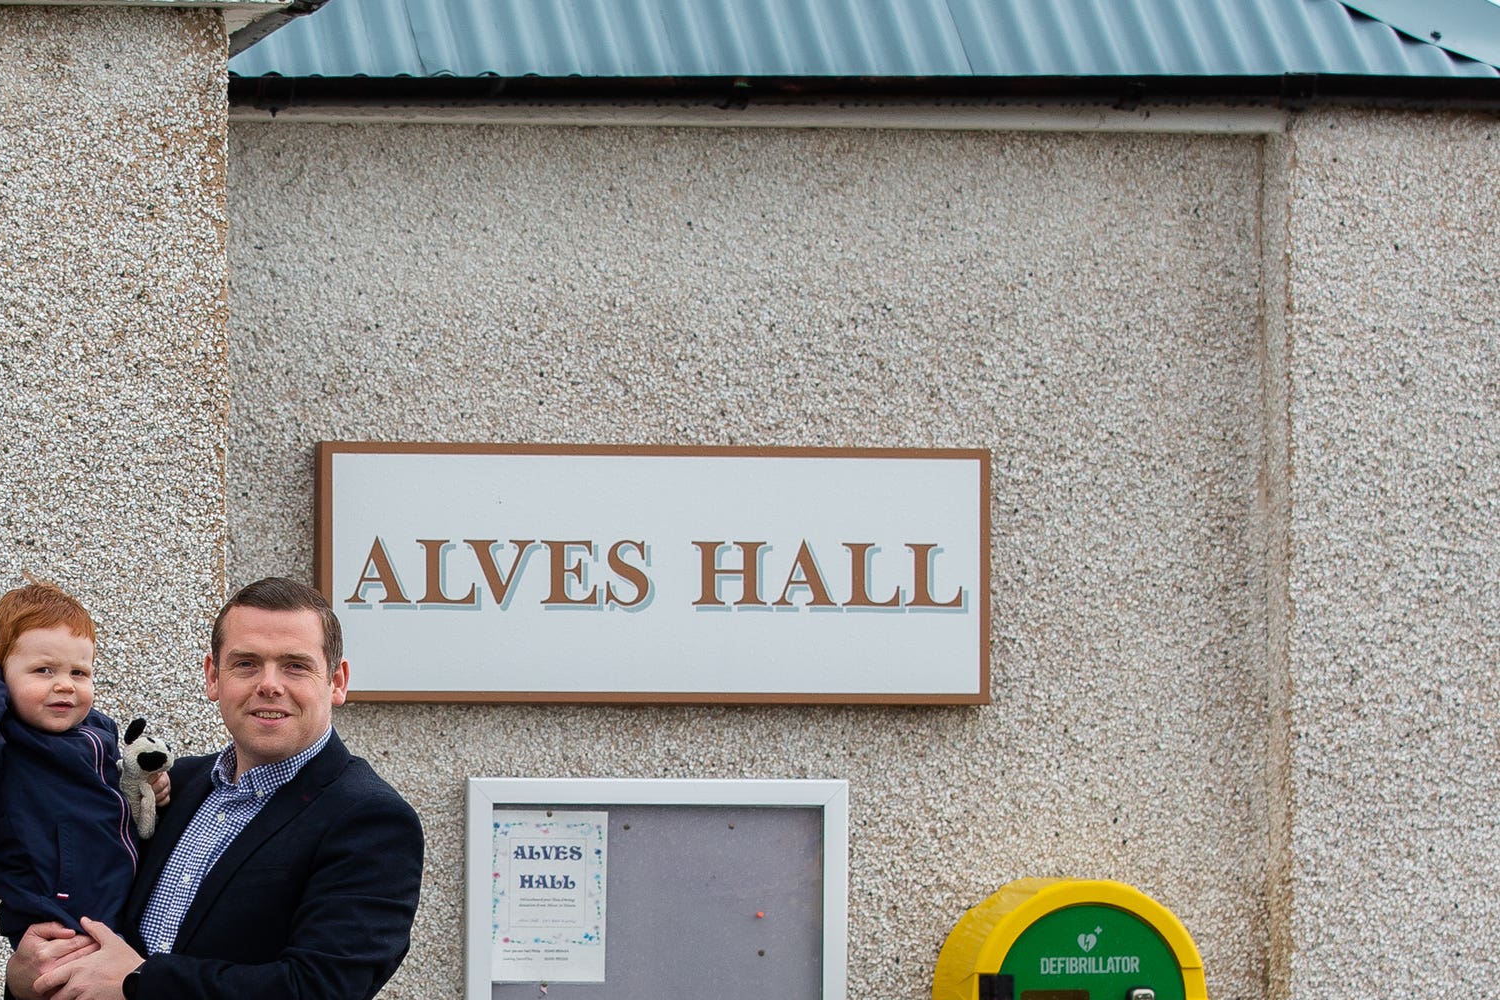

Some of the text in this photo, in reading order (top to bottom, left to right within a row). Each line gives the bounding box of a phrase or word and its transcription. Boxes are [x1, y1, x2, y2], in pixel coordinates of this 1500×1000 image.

[345, 535, 968, 614] ALVES HALL
[513, 845, 583, 860] ALVES
[519, 874, 576, 889] HALL
[1040, 955, 1140, 974] DEFIBRILLATOR
